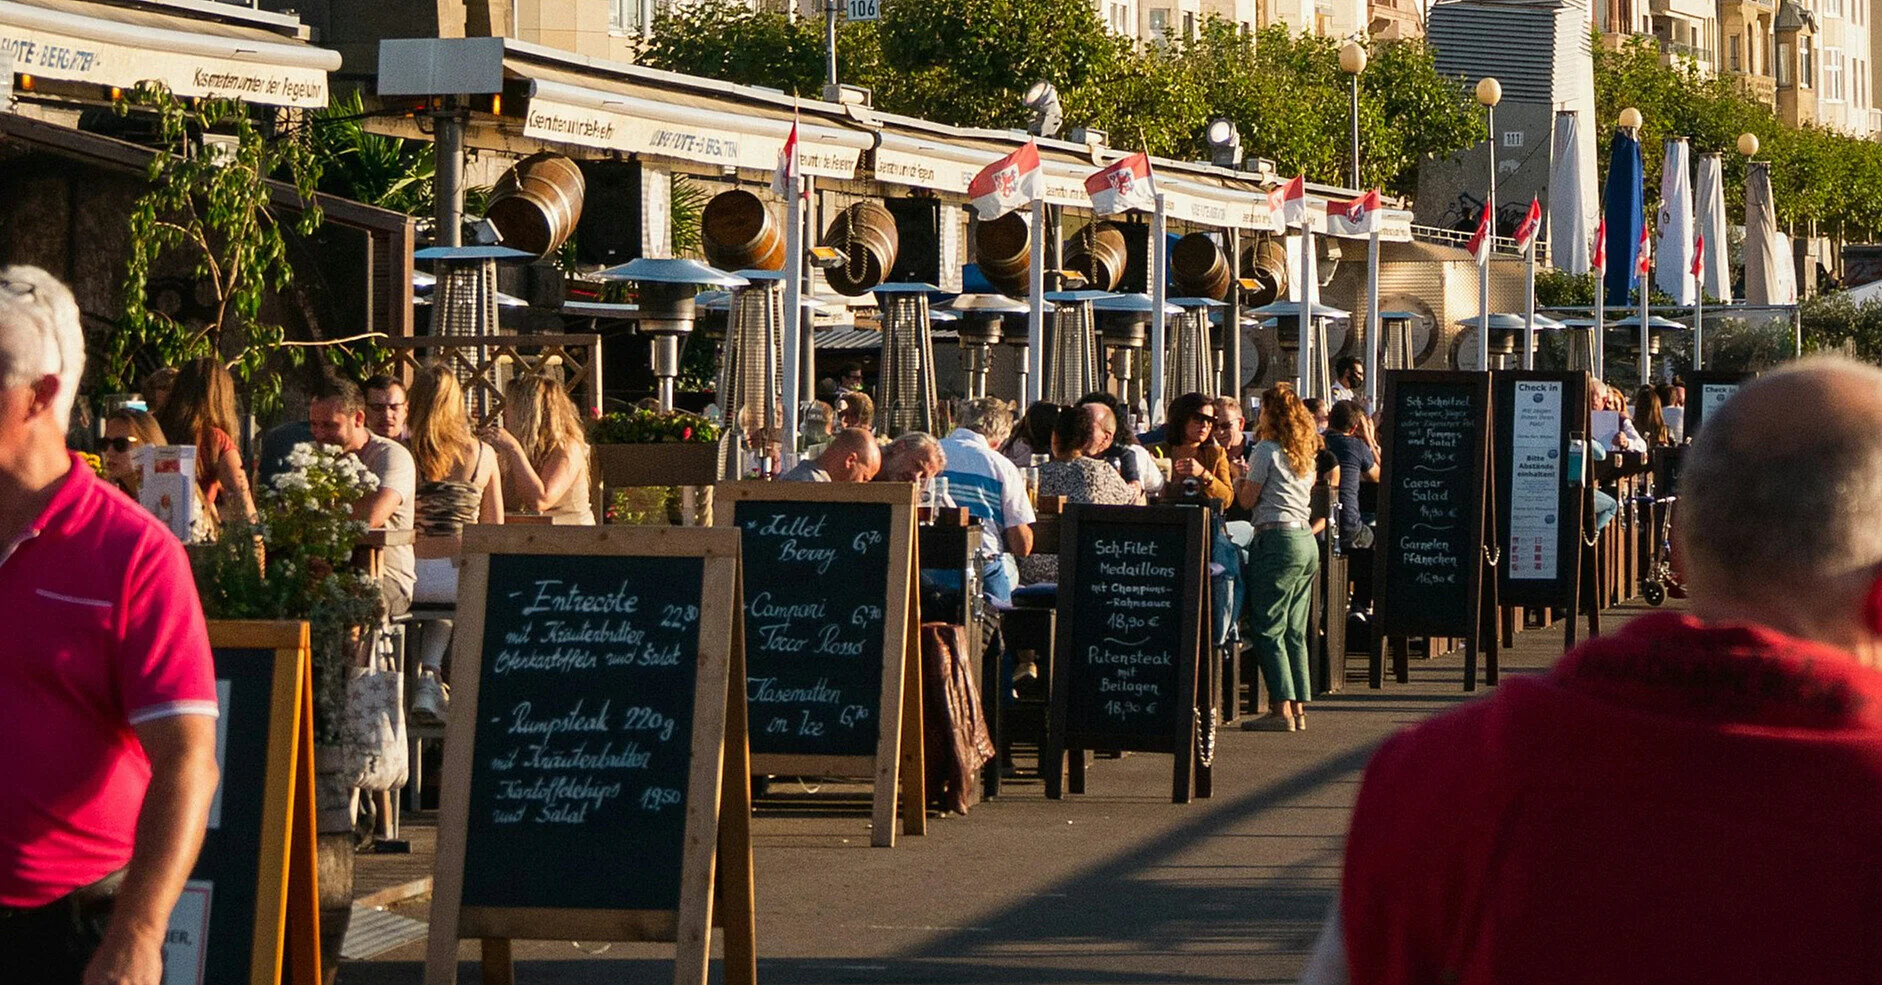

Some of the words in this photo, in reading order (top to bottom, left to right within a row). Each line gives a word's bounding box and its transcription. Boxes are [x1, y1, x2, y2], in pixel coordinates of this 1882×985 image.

[851, 0, 875, 17] 106
[1507, 133, 1520, 145] 111
[1518, 383, 1547, 391] Check
[1549, 383, 1558, 391] in
[1427, 395, 1470, 408] Schnitzel
[1429, 438, 1457, 447] Salat
[1403, 477, 1444, 489] Caesar
[1412, 490, 1449, 502] Salad
[759, 514, 828, 538] Lillet
[1400, 535, 1449, 552] Garnelen
[778, 539, 839, 575] Berry
[1100, 562, 1176, 578] Medaillons
[751, 592, 827, 625] Campari
[505, 621, 531, 644] mit
[1107, 612, 1145, 634] 18,90
[1149, 616, 1160, 627] €
[759, 623, 809, 652] Tocco
[814, 623, 865, 656] Rosso
[495, 648, 598, 676] Ofenkartoffeln
[606, 647, 637, 666] und
[637, 643, 681, 666] Salat
[1088, 645, 1173, 666] Putensteak
[1117, 667, 1138, 679] mit
[747, 677, 841, 704] Kasematten
[1099, 678, 1159, 696] Beilagen
[1104, 700, 1141, 721] 18,90
[508, 699, 609, 746] Rumpsteak
[799, 710, 824, 736] Ice
[492, 747, 520, 770] mit
[493, 804, 527, 823] und
[535, 801, 589, 823] Salat
